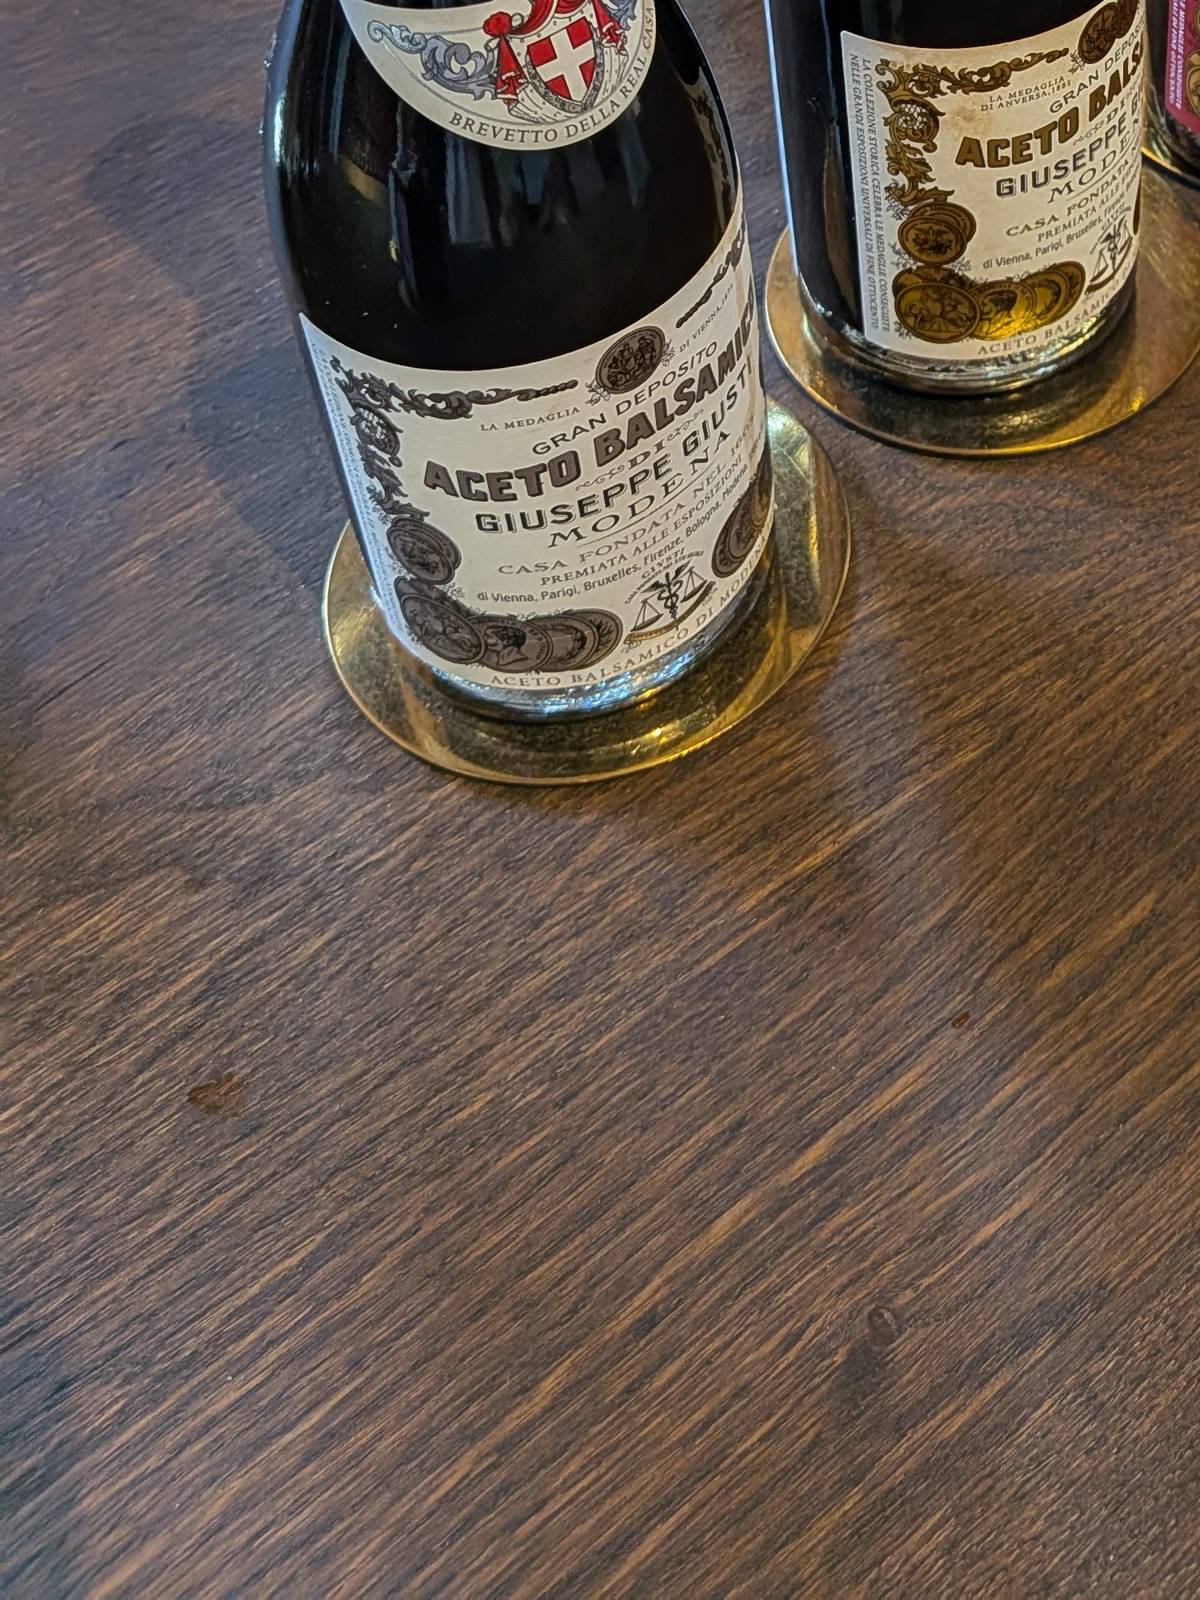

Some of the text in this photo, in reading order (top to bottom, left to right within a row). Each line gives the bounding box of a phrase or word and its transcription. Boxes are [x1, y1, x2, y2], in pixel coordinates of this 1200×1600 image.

[449, 6, 657, 144] BREVETTO DELLA REAL CASA
[850, 53, 861, 86] NELLE
[862, 58, 871, 71] LA
[989, 75, 1066, 103] LA MEDAGLIA
[853, 86, 864, 124] GRANDI
[863, 74, 877, 136] COLLEZIONE
[955, 106, 1080, 168] ACETO
[1088, 32, 1143, 123] BALS
[980, 103, 995, 112] DI
[1050, 69, 1100, 114] GRAN
[1106, 97, 1126, 125] DI
[856, 124, 869, 188] ESPOSIZIONI
[868, 135, 880, 176] STORICA
[996, 111, 1127, 198] GIUSEPPE
[861, 188, 873, 242] UNIVERSALI
[871, 176, 882, 219] CELEBRA
[1006, 215, 1059, 237] CASA
[1066, 159, 1130, 216] FONDATA
[875, 220, 884, 231] LE
[1037, 205, 1097, 242] PREMIATA
[866, 252, 876, 276] FINE
[983, 259, 993, 269] di
[996, 251, 1033, 269] Vienna,
[1035, 238, 1064, 257] Parigi,
[977, 334, 1037, 355] ACETO
[424, 450, 582, 502] ACETO
[593, 274, 755, 467] BALSAMICO
[480, 339, 690, 432] LA MEDAGLIA DI
[532, 341, 718, 455] GRAN DEPOSITO
[475, 355, 753, 534] GIUSEPPE GIUSTI
[628, 439, 665, 471] DI
[548, 430, 732, 549] MODENA
[498, 462, 727, 575] CASA FONDATA NEL
[540, 554, 628, 587] PREMIATA
[632, 528, 670, 557] ALLE
[673, 454, 743, 531] ESPOSIZIONI
[477, 590, 488, 601] di
[491, 592, 539, 603] Vienna,
[541, 585, 581, 601] Parigi,
[583, 564, 642, 593] Bruxelles,
[643, 536, 685, 565] Firenze,
[685, 499, 722, 539] Bologna,
[641, 547, 686, 580] GIVSTI
[491, 606, 714, 687] ACETO BALSAMICO DI
